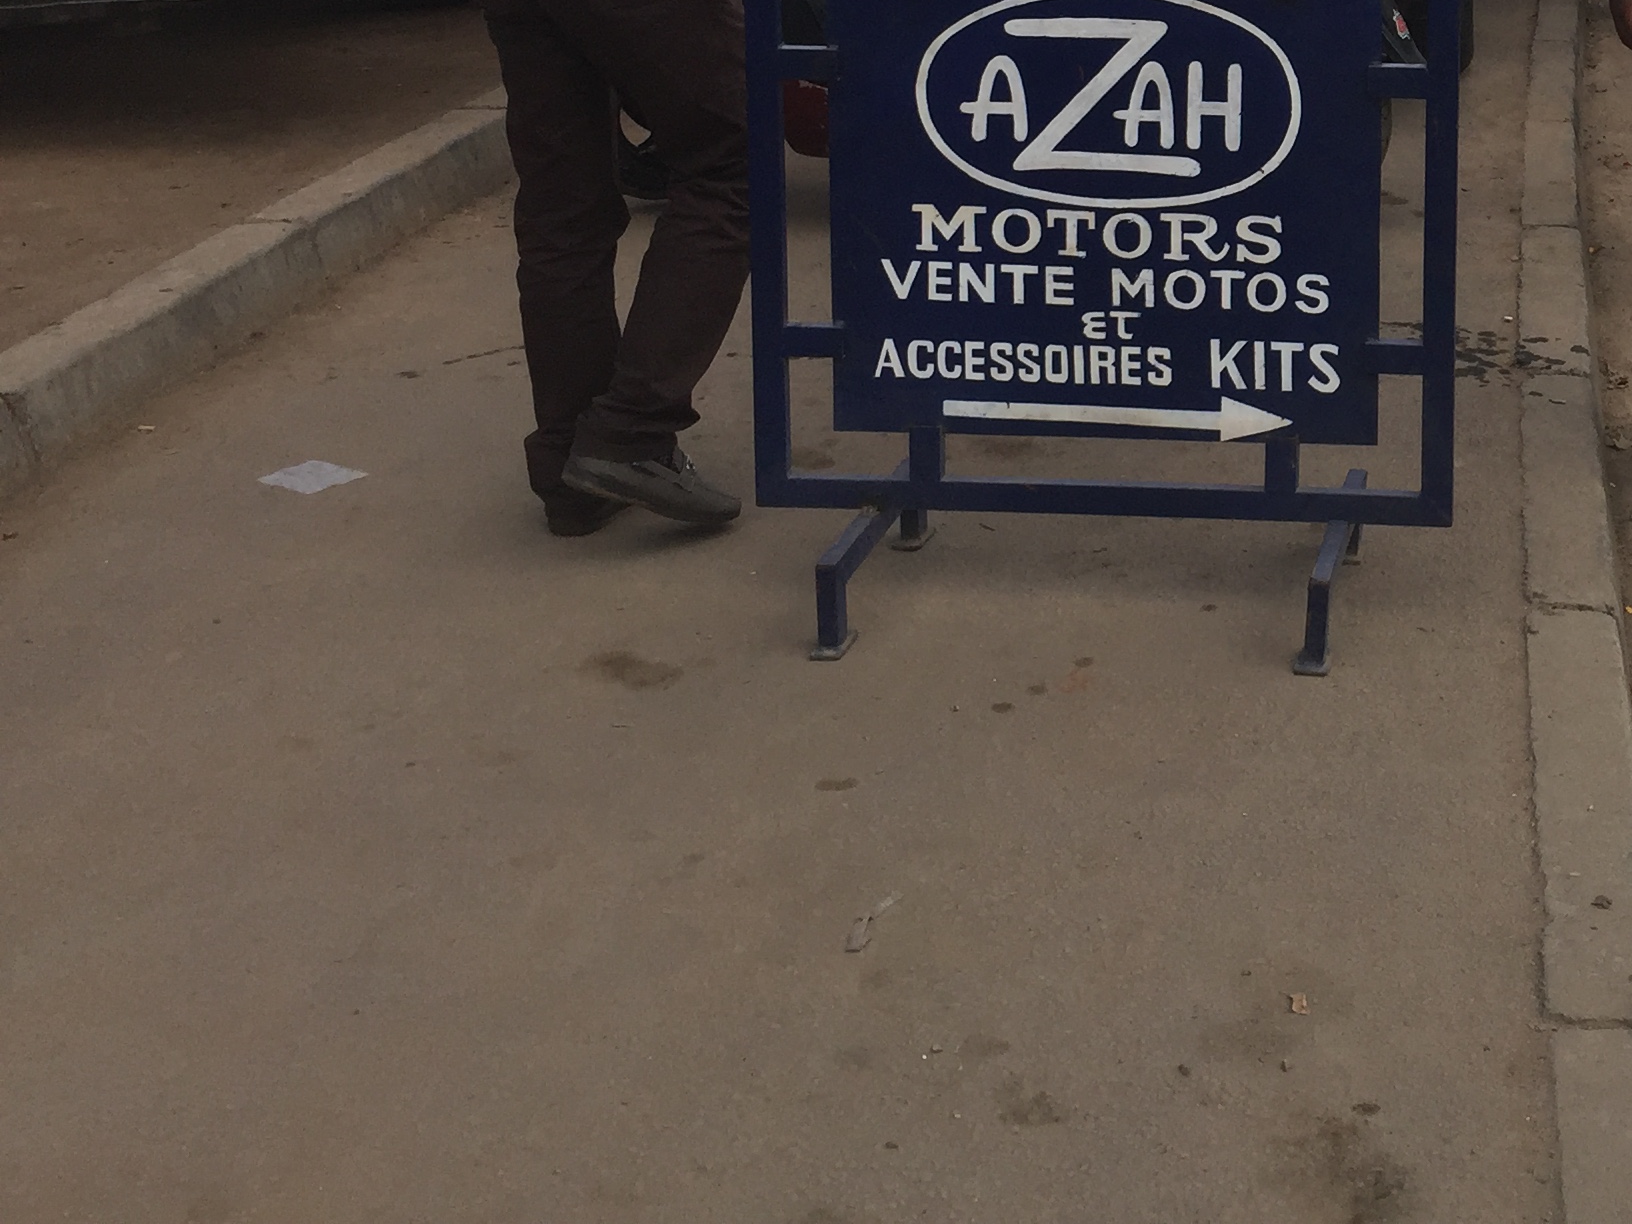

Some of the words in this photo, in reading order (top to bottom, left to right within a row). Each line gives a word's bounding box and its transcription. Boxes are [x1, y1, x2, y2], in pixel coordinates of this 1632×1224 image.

[959, 15, 1244, 179] AZAH
[911, 203, 1284, 264] MOTORS
[880, 258, 1076, 306] VENTE
[1109, 268, 1331, 315] MOTOS
[874, 338, 1174, 387] ACCESSOIRES
[1208, 338, 1342, 394] KITS
